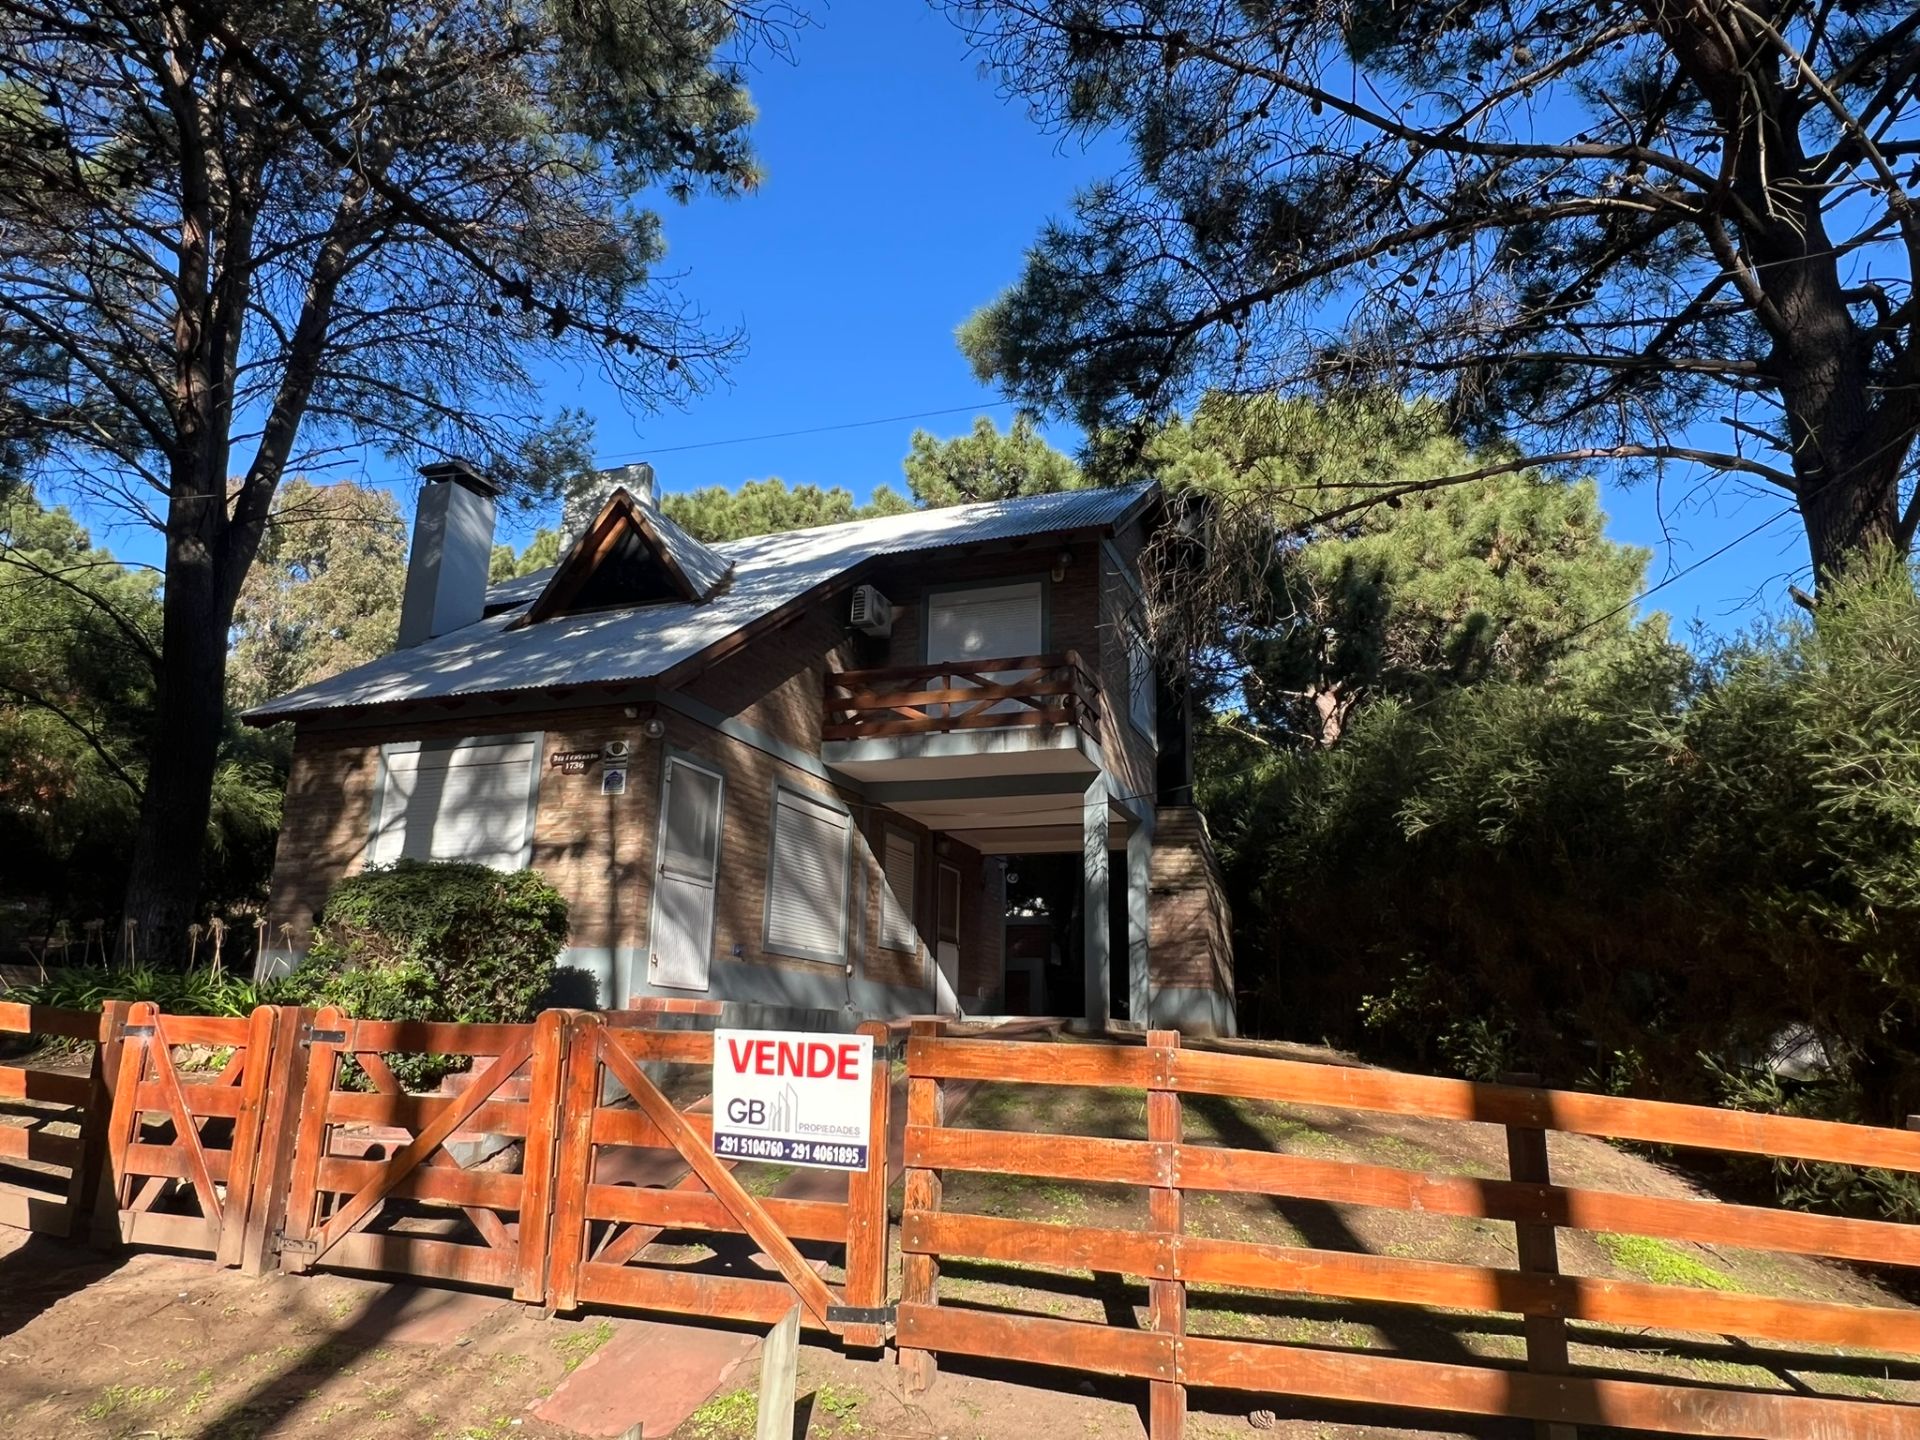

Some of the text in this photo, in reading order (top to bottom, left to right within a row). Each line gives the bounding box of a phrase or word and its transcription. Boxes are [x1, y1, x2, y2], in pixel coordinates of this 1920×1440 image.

[728, 1038, 860, 1080] VENDE
[727, 1097, 766, 1125] GB
[798, 1122, 861, 1136] PROPIEDADES
[720, 1136, 738, 1153] 291
[740, 1138, 784, 1157] 5104760
[791, 1142, 810, 1160] 291
[812, 1144, 859, 1164] 4061895
